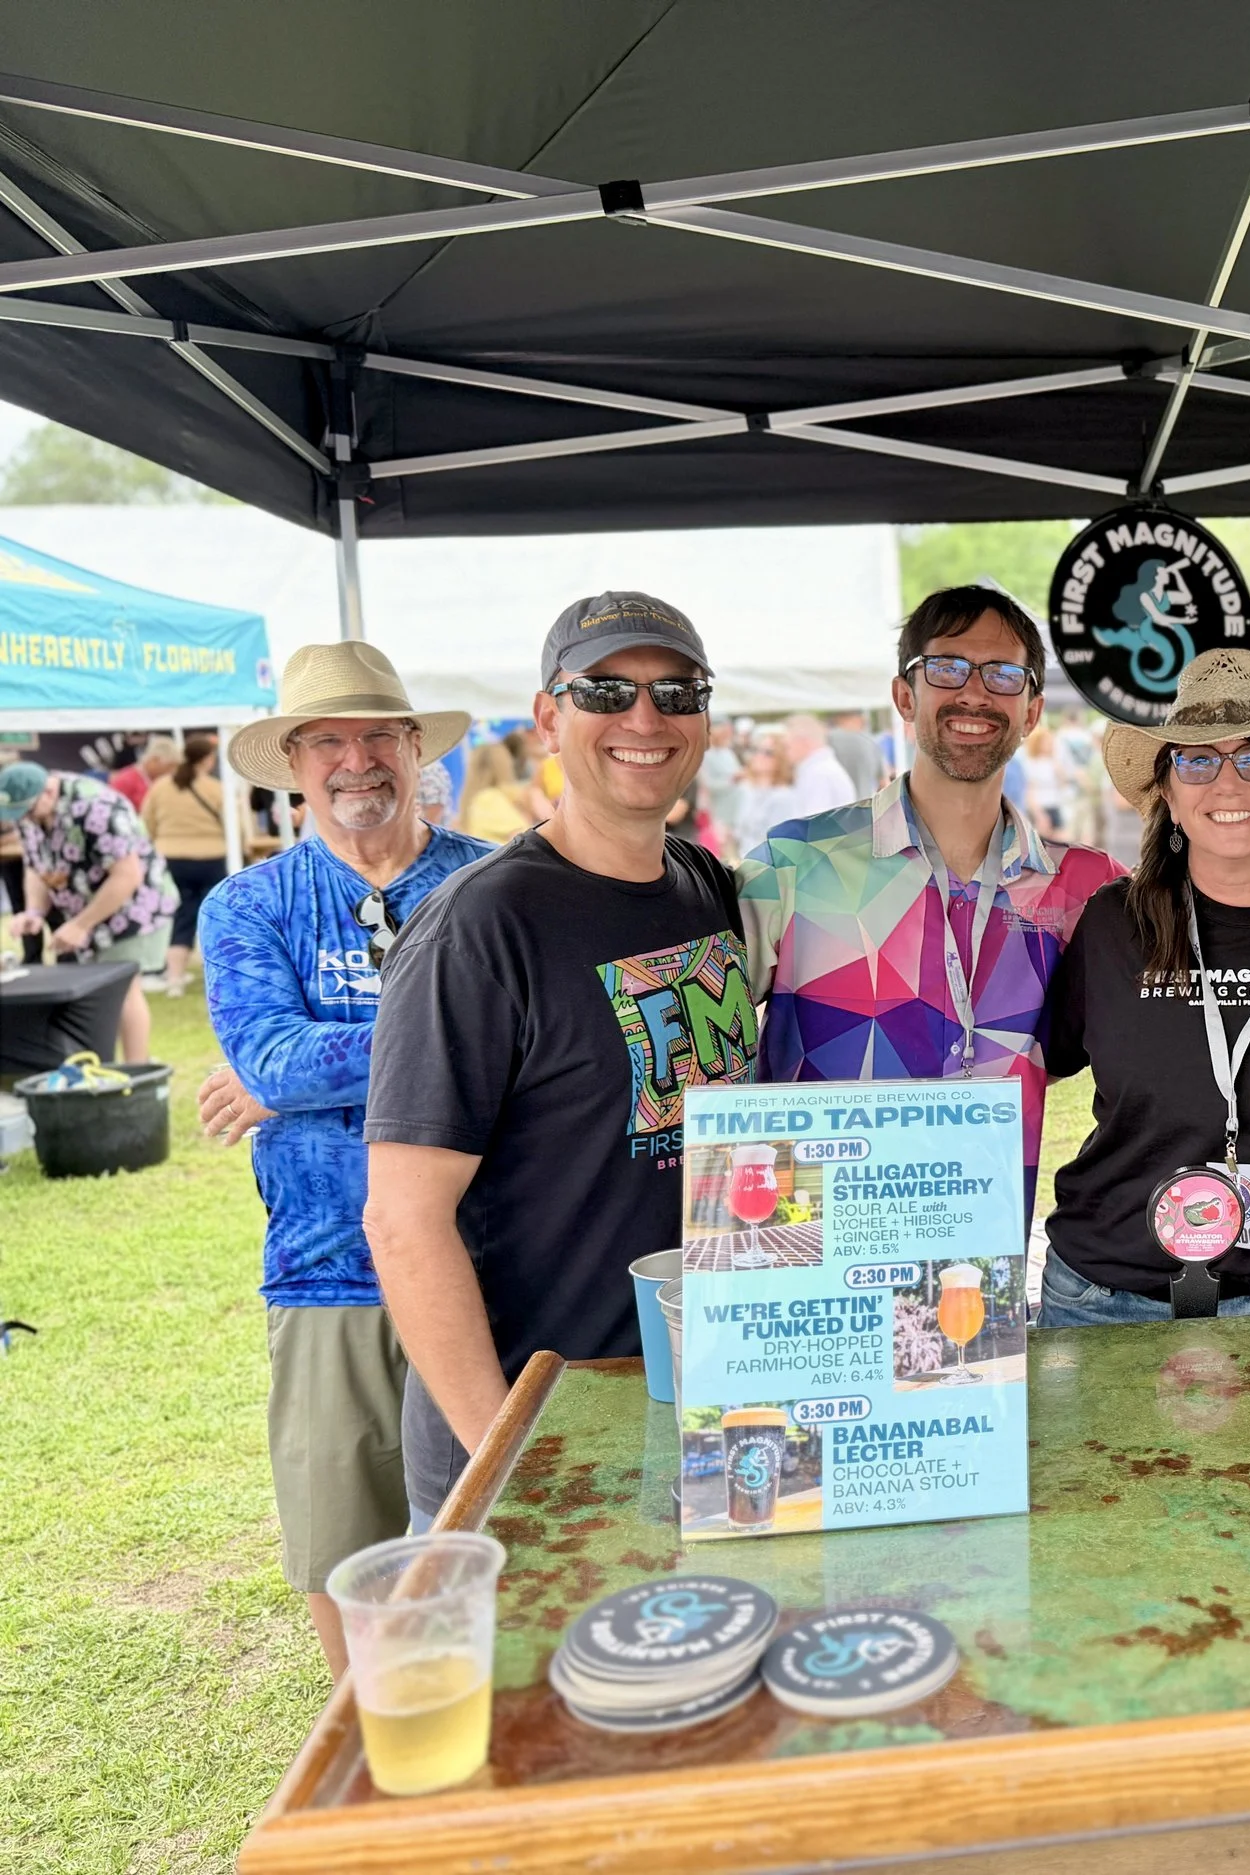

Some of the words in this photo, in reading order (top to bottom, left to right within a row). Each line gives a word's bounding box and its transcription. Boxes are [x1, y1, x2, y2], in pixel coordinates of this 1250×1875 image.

[1061, 542, 1105, 635] FIRST
[1105, 522, 1246, 637] MAGNITUDE
[143, 642, 235, 674] FLORIDIAN
[1064, 650, 1095, 664] GNV
[1098, 677, 1174, 717] BREWIN
[1142, 970, 1198, 985] FIT
[1140, 986, 1229, 999] BREWIG
[735, 1098, 778, 1107] FIRST
[783, 1094, 872, 1106] MAGNITUDE
[877, 1091, 946, 1103] BREWING
[951, 1091, 975, 1101] CO.
[690, 1110, 813, 1136] TIMED
[824, 1102, 1017, 1130] TAPPINGS
[631, 1131, 683, 1159] FIRS
[804, 1142, 835, 1159] 1:30
[838, 1141, 862, 1157] PM
[833, 1161, 962, 1183] ALLIGATOR
[833, 1178, 993, 1201] STRAWBERRY
[833, 1203, 883, 1217] SOUR
[886, 1201, 917, 1214] ALE
[922, 1201, 947, 1213] with
[833, 1216, 887, 1230] LYCHEE
[892, 1218, 900, 1226] +
[904, 1212, 973, 1226] HIBISCUS
[903, 1230, 912, 1239] +
[915, 1226, 955, 1238] ROSE
[833, 1244, 866, 1257] ABV:
[869, 1243, 900, 1255] 5.5%
[852, 1268, 886, 1285] 2:30
[890, 1267, 914, 1282] PM
[742, 1317, 844, 1340] FUNKED
[850, 1314, 883, 1333] UP
[764, 1334, 883, 1356] DRY-HOPPED
[726, 1353, 844, 1374] FARMHOUSE
[850, 1350, 883, 1366] ALE
[811, 1373, 847, 1386] ABV:
[850, 1368, 884, 1382] 6.4%
[800, 1402, 835, 1419] 3:30
[838, 1400, 863, 1416] PM
[833, 1415, 994, 1445] BANANABAL
[728, 1444, 739, 1471] FIRST
[739, 1436, 781, 1468] MAGNITUDE
[833, 1440, 924, 1465] LECTER
[833, 1458, 946, 1481] CHOCOLATE
[952, 1460, 962, 1471] +
[833, 1478, 914, 1498] BANANA
[920, 1472, 980, 1491] STOUT
[833, 1501, 869, 1515] ABV:
[873, 1498, 906, 1512] 4.3%
[811, 1613, 885, 1633] FIRST
